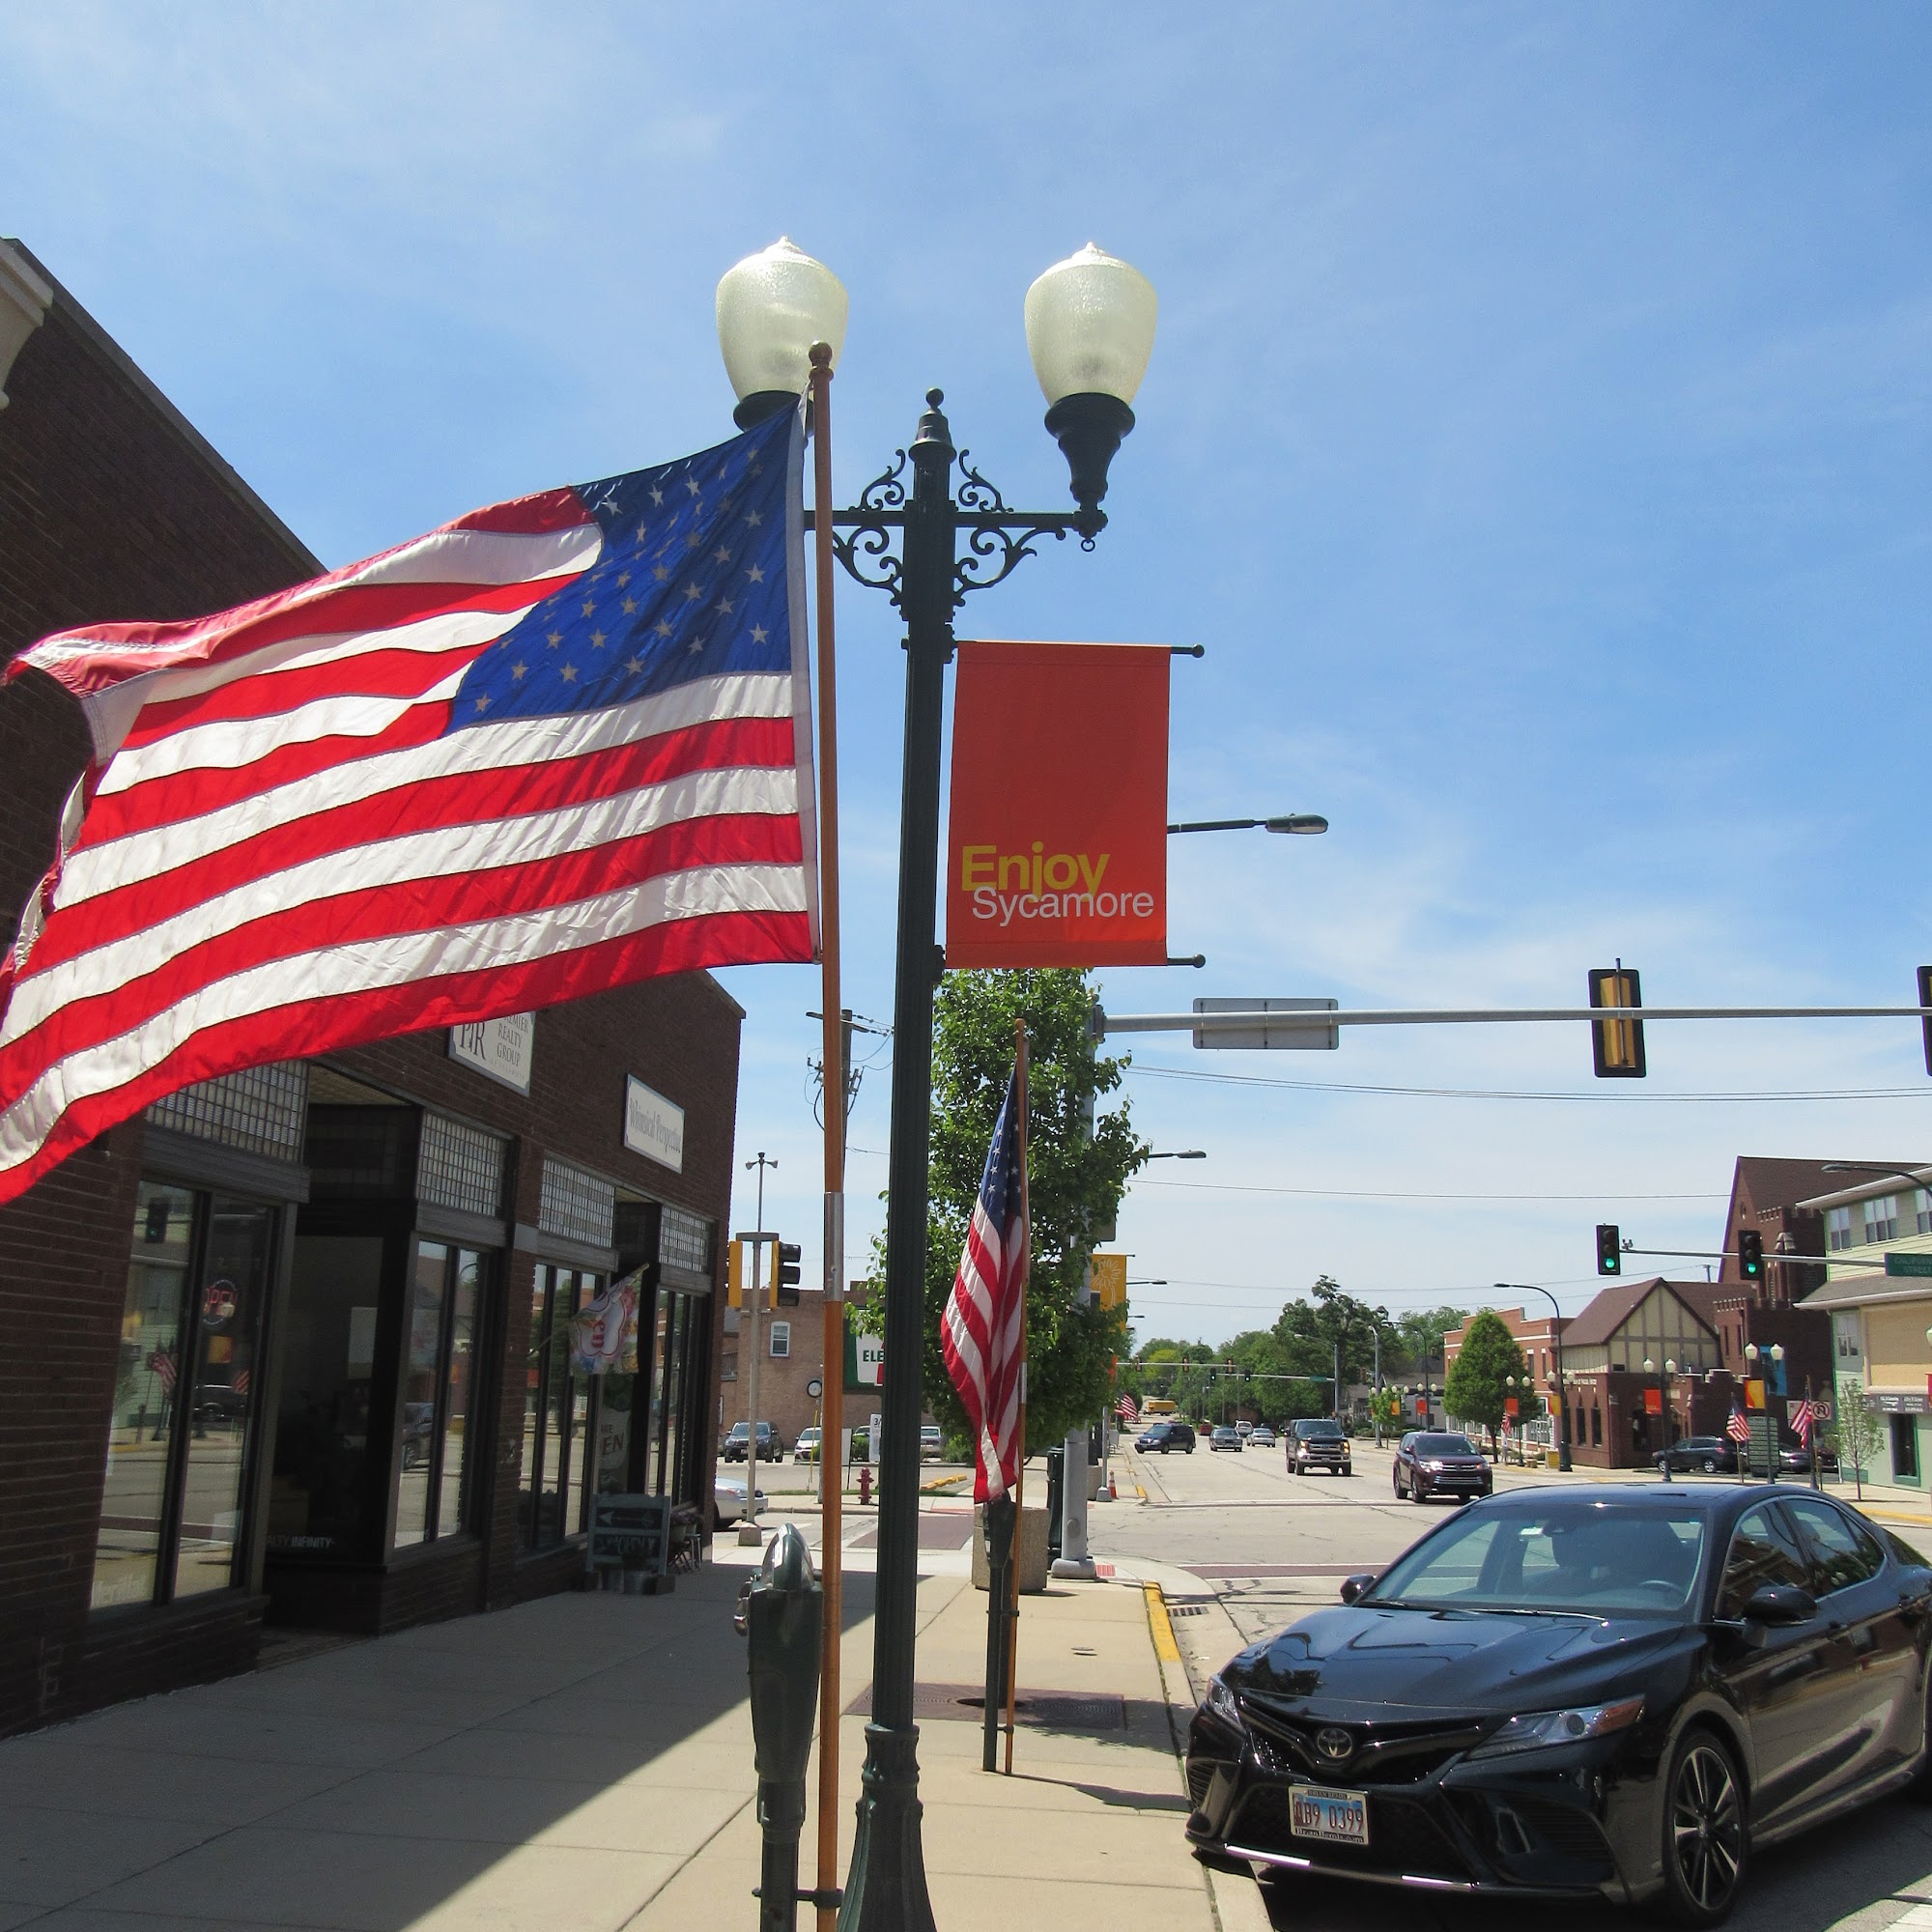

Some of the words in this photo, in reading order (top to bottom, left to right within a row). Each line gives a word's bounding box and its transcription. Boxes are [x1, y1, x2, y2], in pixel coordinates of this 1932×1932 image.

[961, 840, 1110, 903] Enjoy
[972, 886, 1154, 927] Sycamore
[497, 1022, 524, 1048] REALTY
[503, 1014, 528, 1033] REMIER
[497, 1042, 522, 1066] GROUP
[863, 1350, 885, 1362] ELE
[602, 1433, 625, 1455] EN
[266, 1534, 291, 1546] ALTY
[292, 1536, 332, 1549] INFINITY
[1328, 1805, 1364, 1833] 0399
